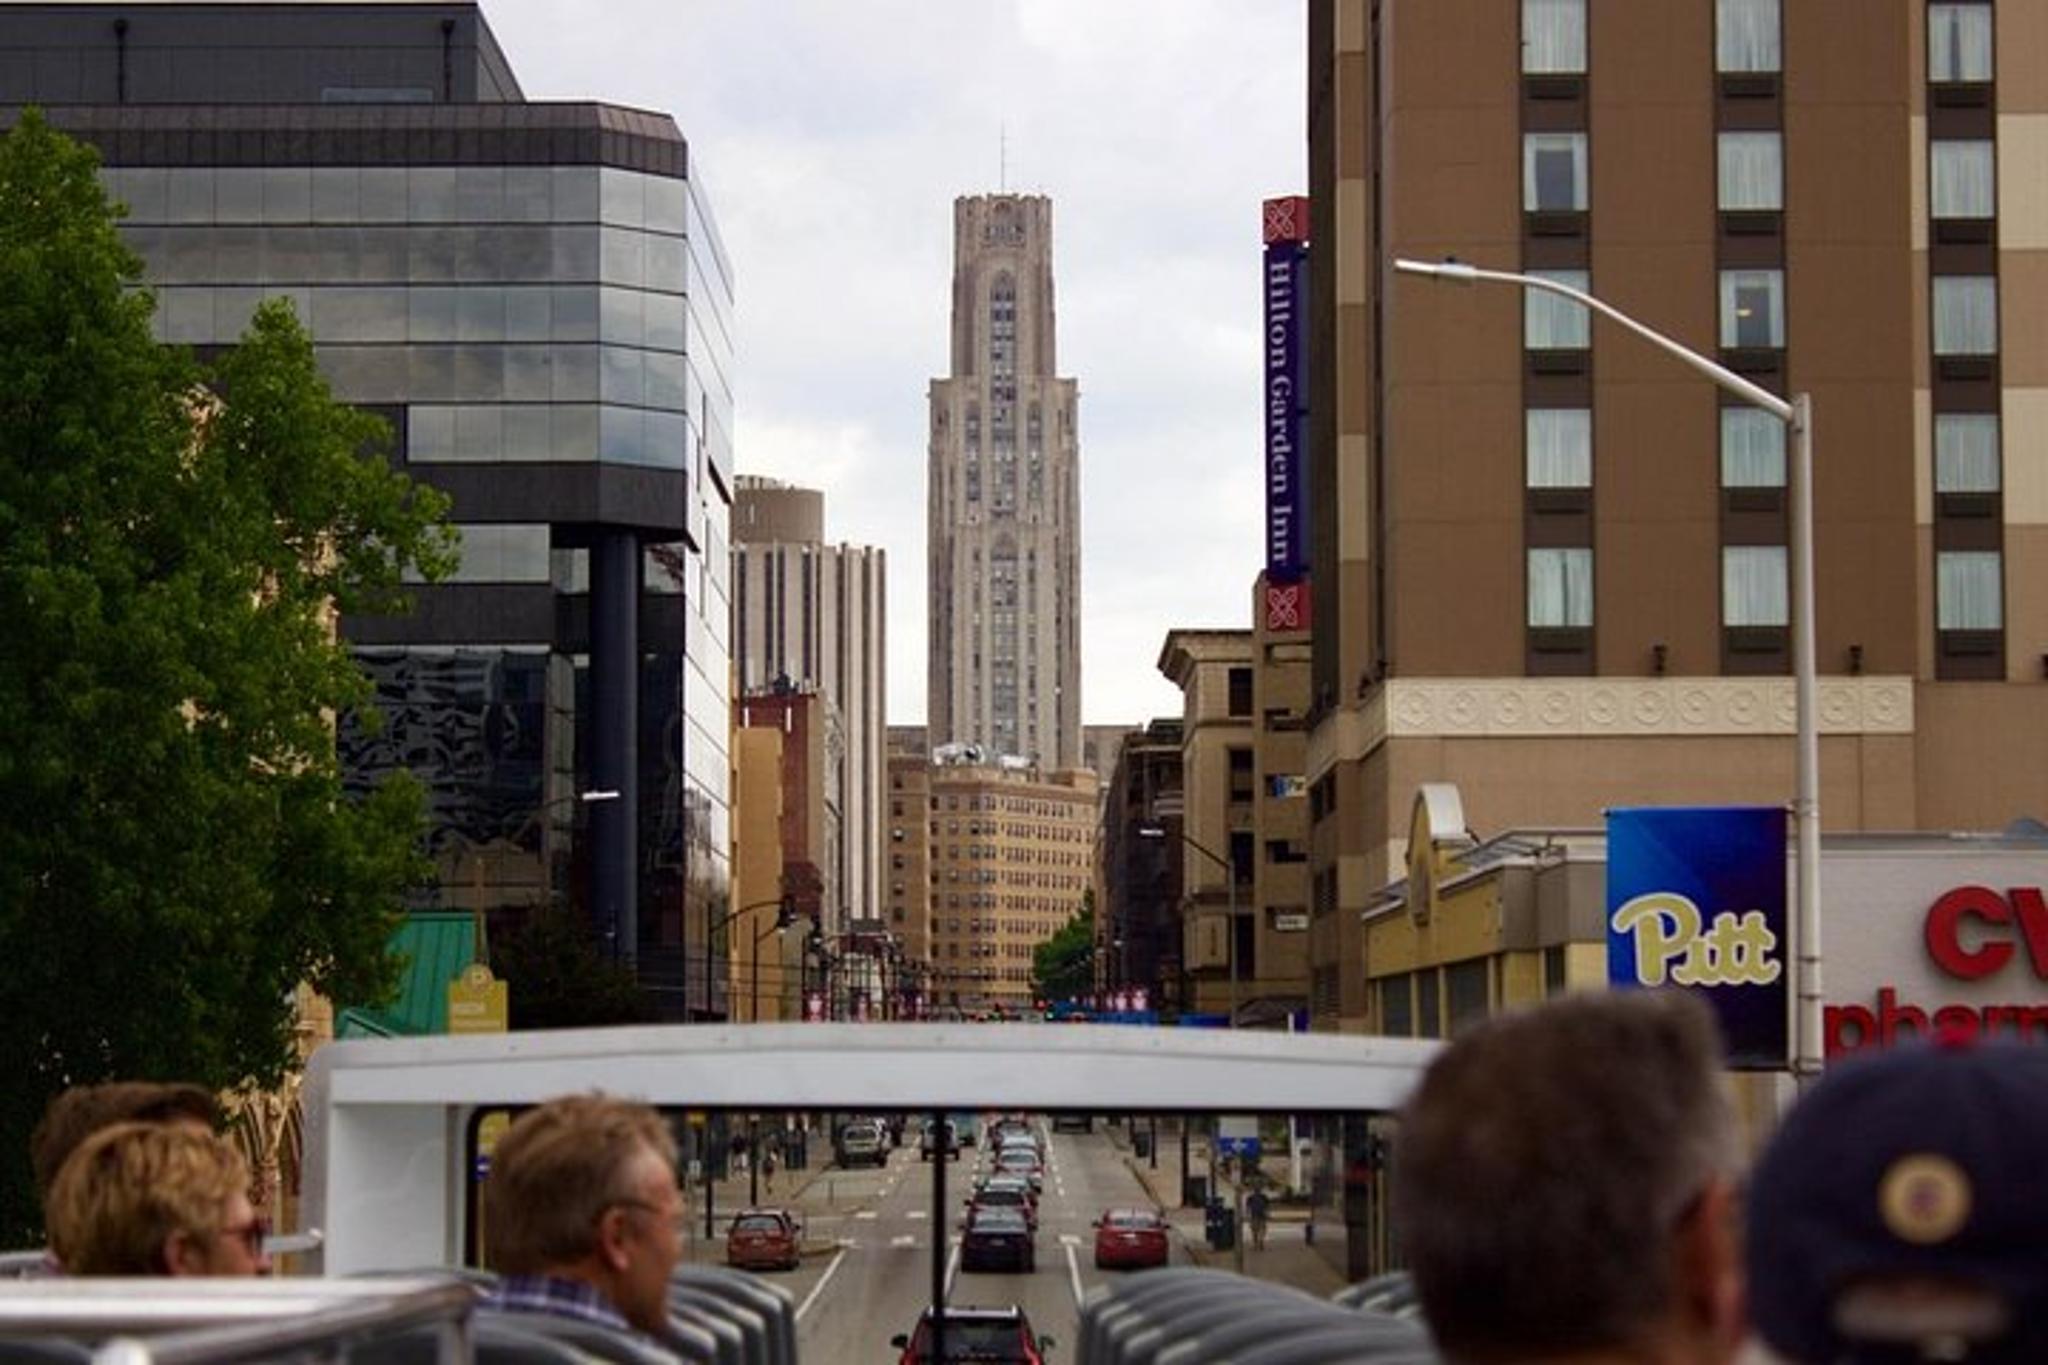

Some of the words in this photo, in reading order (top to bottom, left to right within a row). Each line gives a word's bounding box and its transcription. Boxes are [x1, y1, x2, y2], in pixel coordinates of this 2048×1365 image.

[1270, 262, 1291, 368] Hilton
[1271, 375, 1292, 494] Garden
[1273, 504, 1292, 561] Inn
[1612, 891, 1782, 987] Pitt
